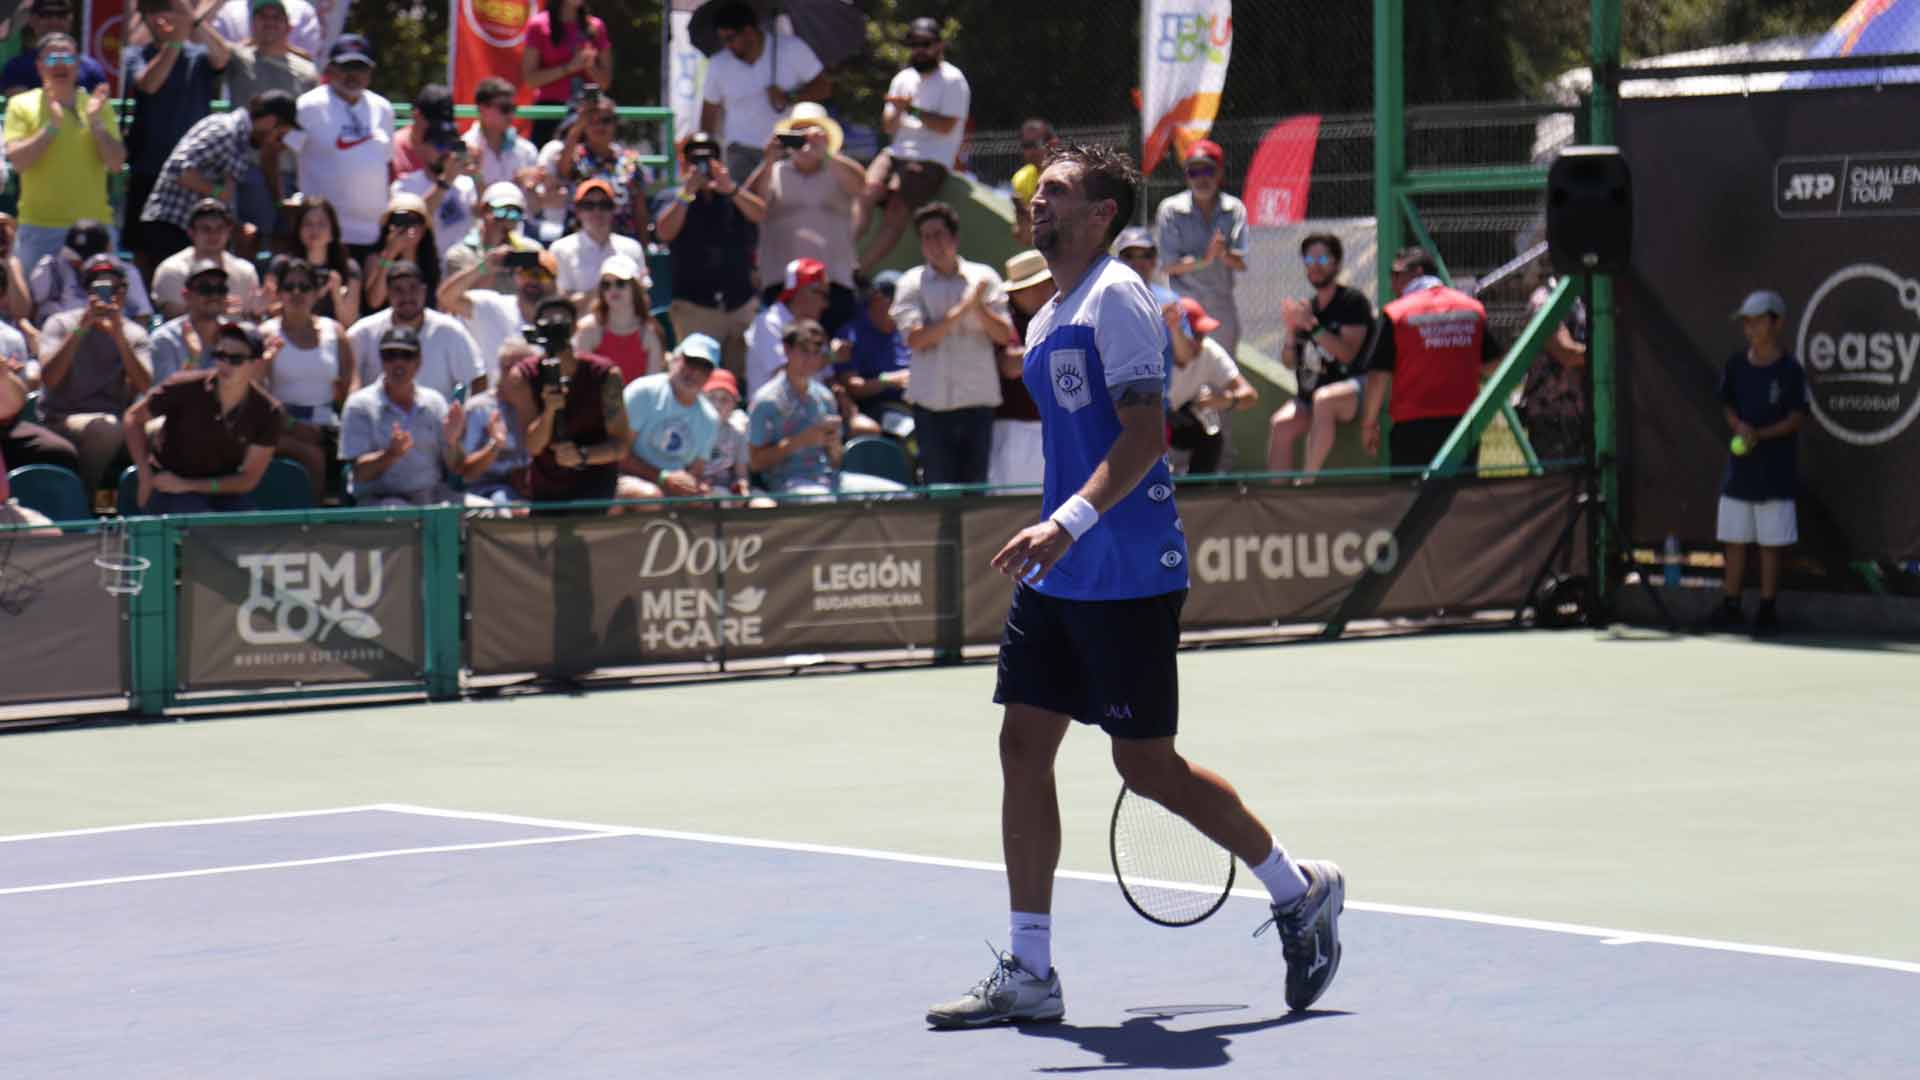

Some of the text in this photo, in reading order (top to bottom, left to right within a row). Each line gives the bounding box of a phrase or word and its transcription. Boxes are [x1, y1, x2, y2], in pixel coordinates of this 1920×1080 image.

[1784, 173, 1836, 200] ATP
[1850, 183, 1894, 203] TOUR
[1809, 331, 1920, 385] easy
[639, 519, 763, 577] Dove
[1197, 529, 1399, 583] arauco
[237, 550, 383, 608] TEMU
[813, 554, 922, 591] LEGIÓN
[237, 597, 320, 645] CO
[641, 589, 725, 619] MEN
[641, 616, 764, 650] +CARE
